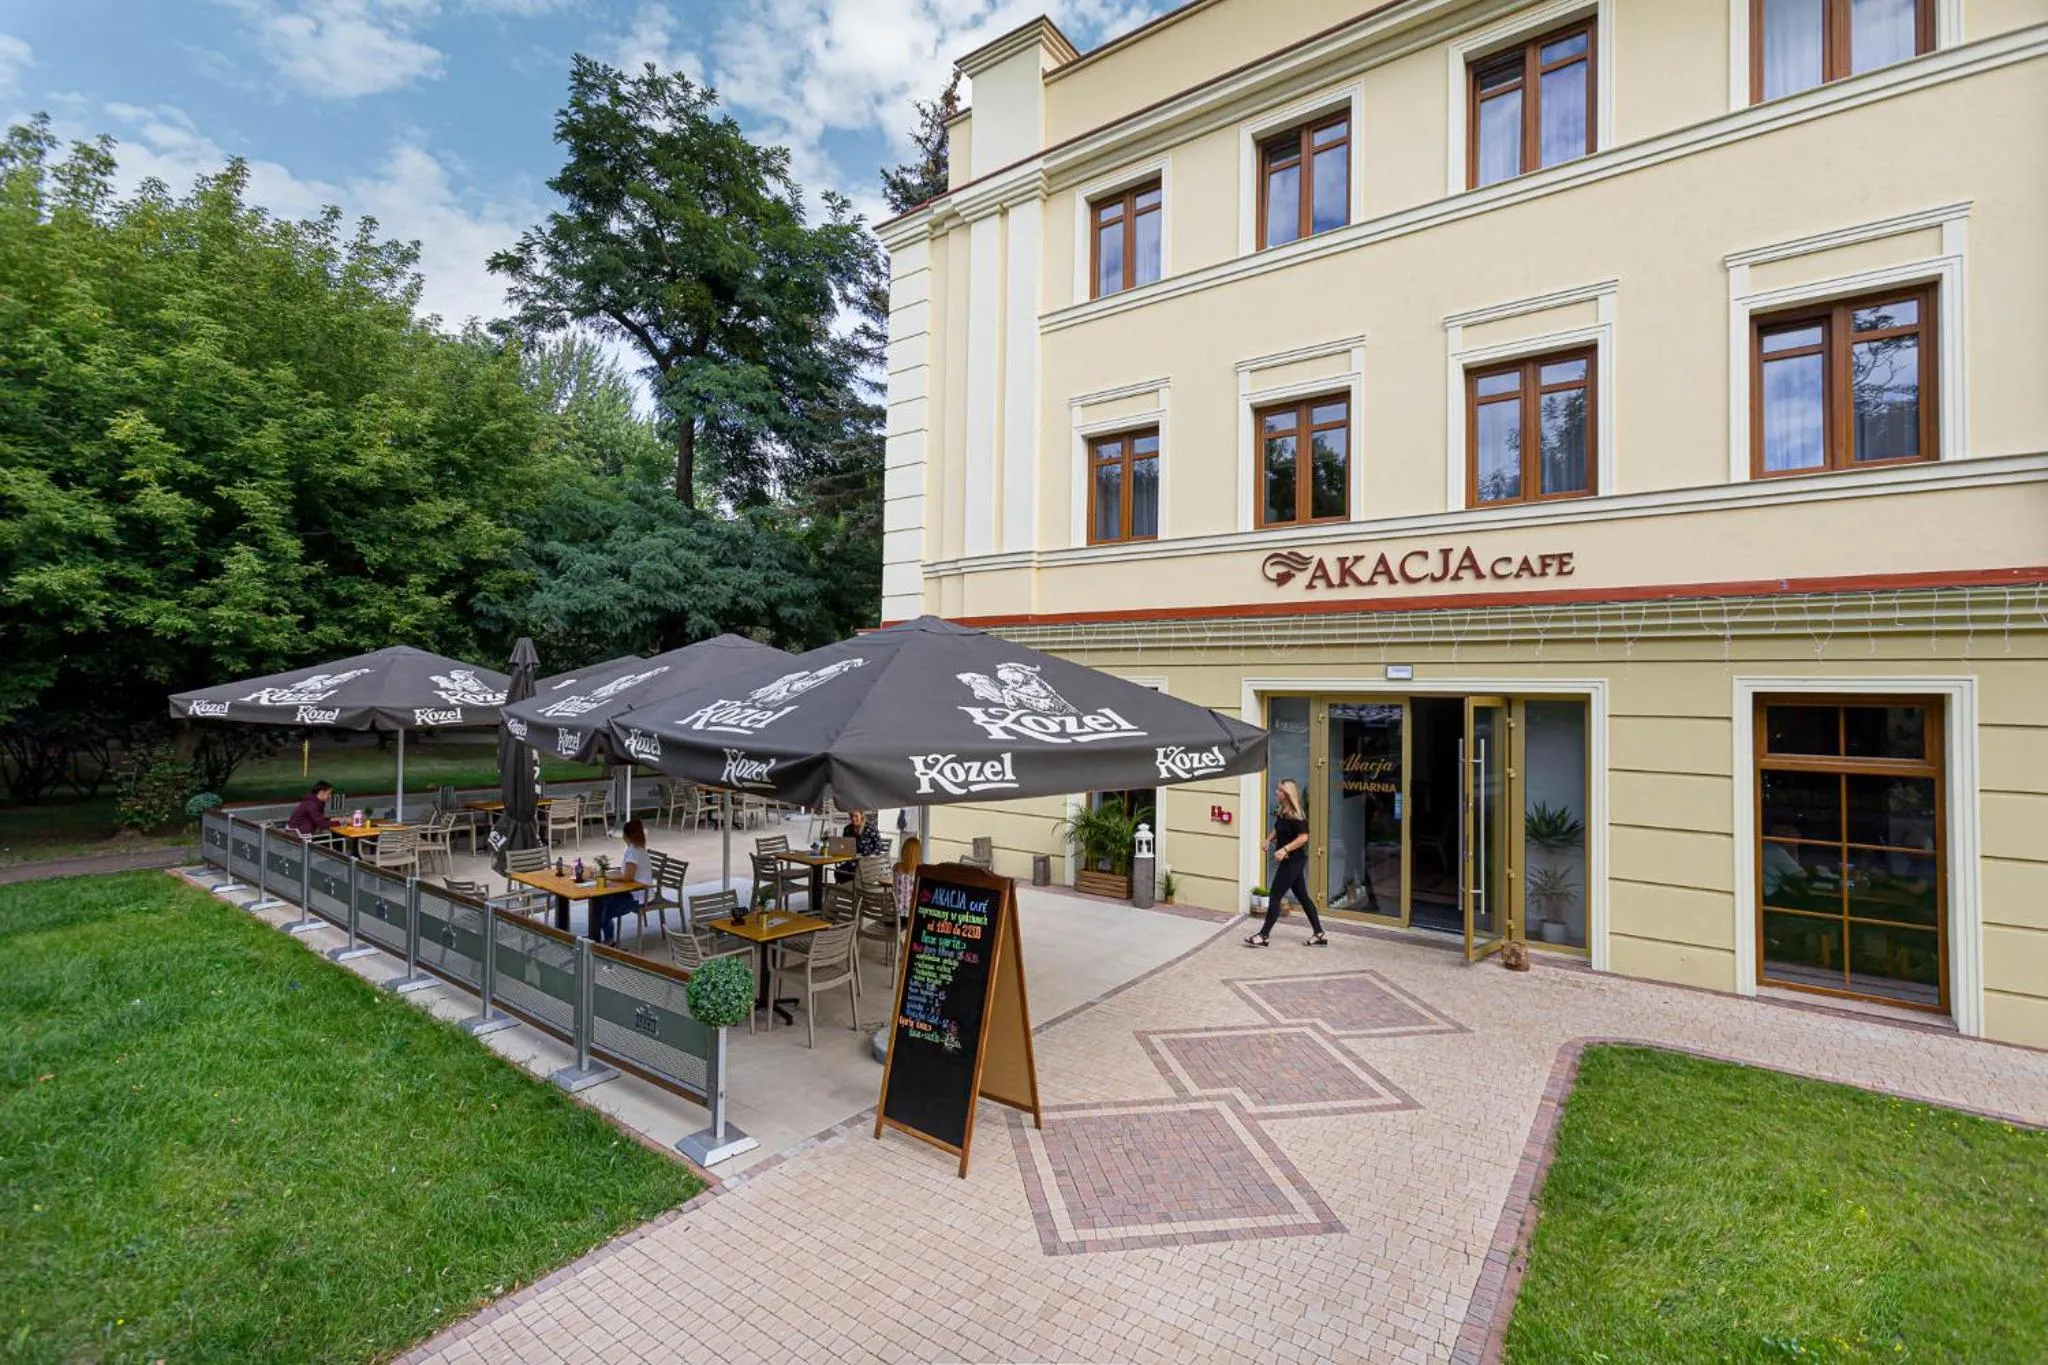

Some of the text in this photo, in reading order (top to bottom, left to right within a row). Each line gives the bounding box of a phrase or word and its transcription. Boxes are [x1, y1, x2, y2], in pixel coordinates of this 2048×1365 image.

[1305, 545, 1576, 590] AKACJA CAFE
[188, 700, 231, 717] Kozel
[294, 705, 341, 725] Kozel
[413, 707, 465, 726] Kozel
[674, 699, 799, 736] Kozel
[957, 705, 1148, 744] Kozel
[557, 727, 582, 755] Kozel
[624, 728, 662, 763] Kozel
[720, 748, 778, 789] Kozel
[909, 751, 1020, 796] Kozel
[1155, 745, 1228, 780] Kozel
[931, 886, 967, 911] AKACJA
